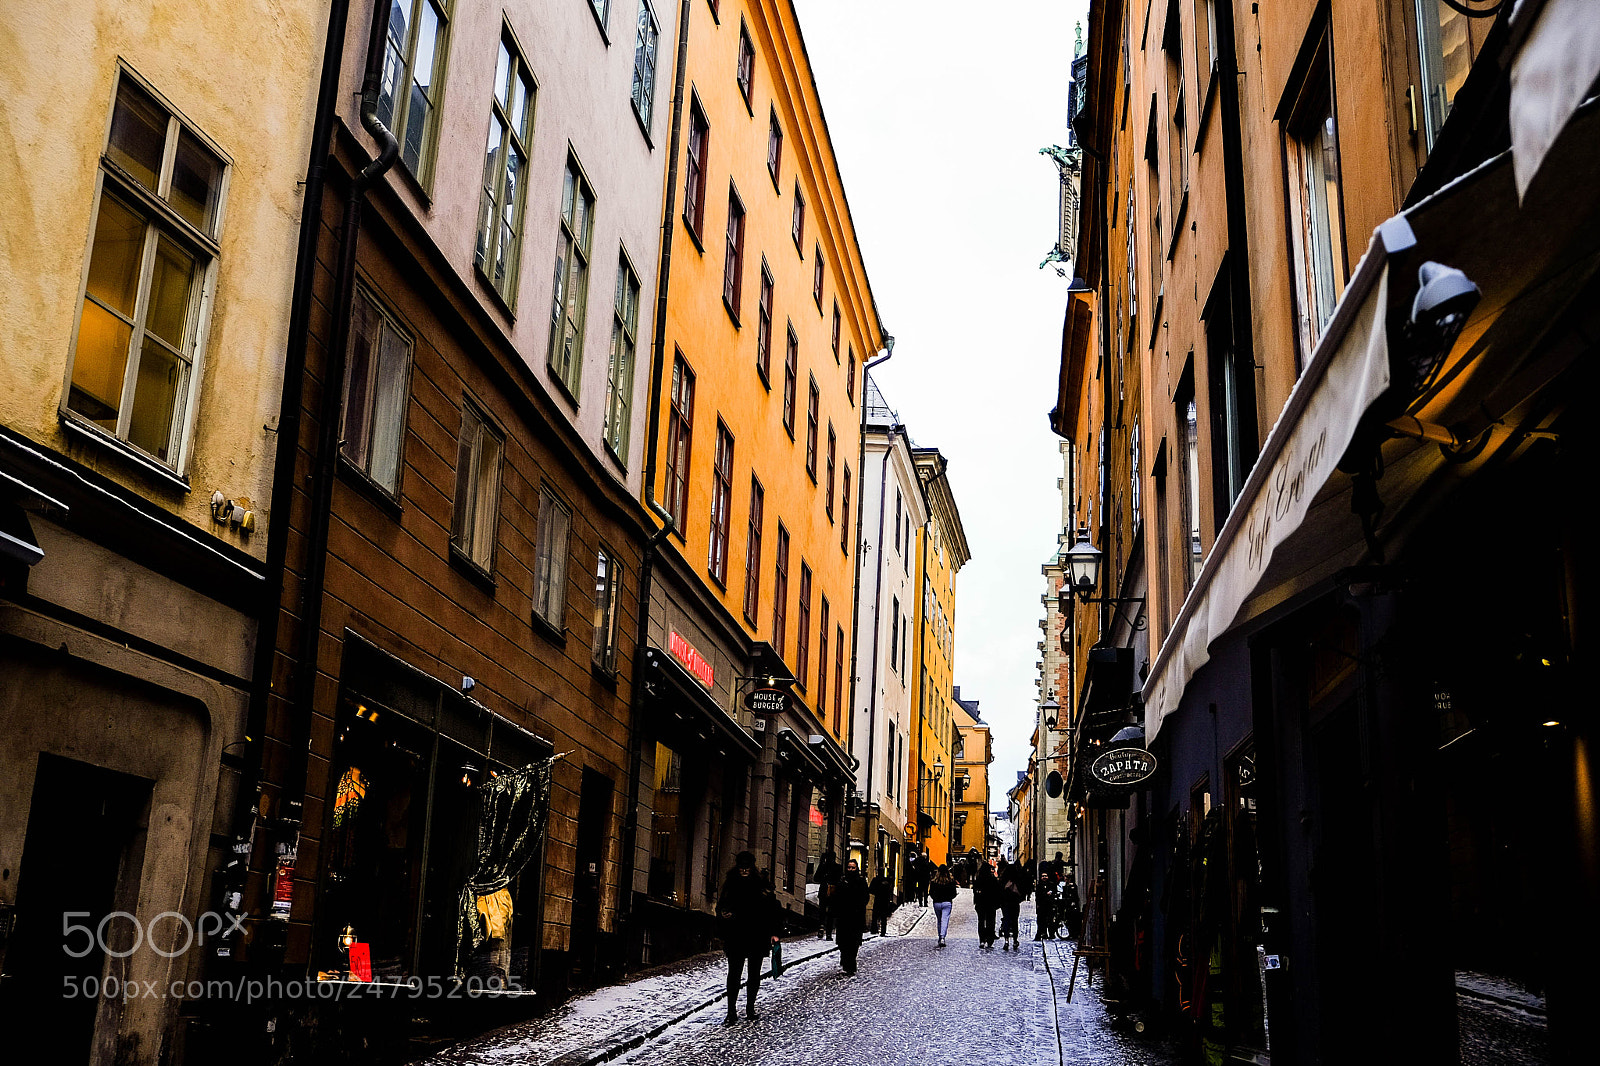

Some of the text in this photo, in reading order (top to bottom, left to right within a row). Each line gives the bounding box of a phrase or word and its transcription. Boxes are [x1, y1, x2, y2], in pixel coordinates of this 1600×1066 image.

[753, 692, 785, 704] HOUSE of
[752, 701, 784, 710] BURGERS
[1100, 760, 1148, 777] ZAPATA
